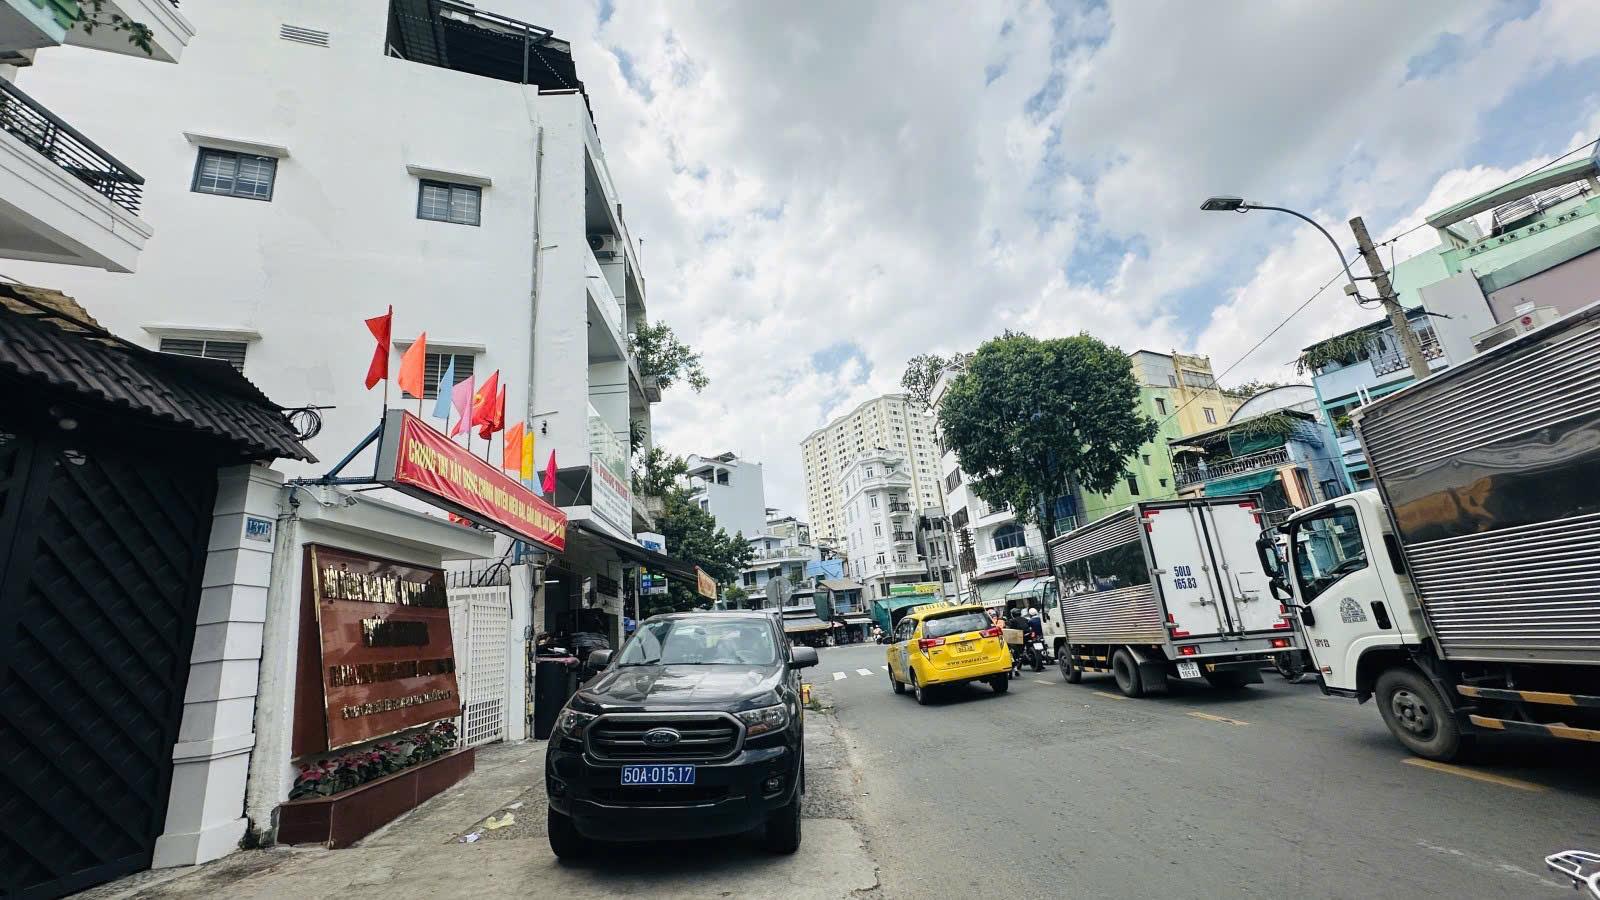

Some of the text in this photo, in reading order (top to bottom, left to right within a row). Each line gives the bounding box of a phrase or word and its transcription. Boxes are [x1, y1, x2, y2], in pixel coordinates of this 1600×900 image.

[1174, 566, 1192, 577] 50LD
[1174, 578, 1198, 590] 165.83
[624, 766, 692, 783] 50A-015.17
